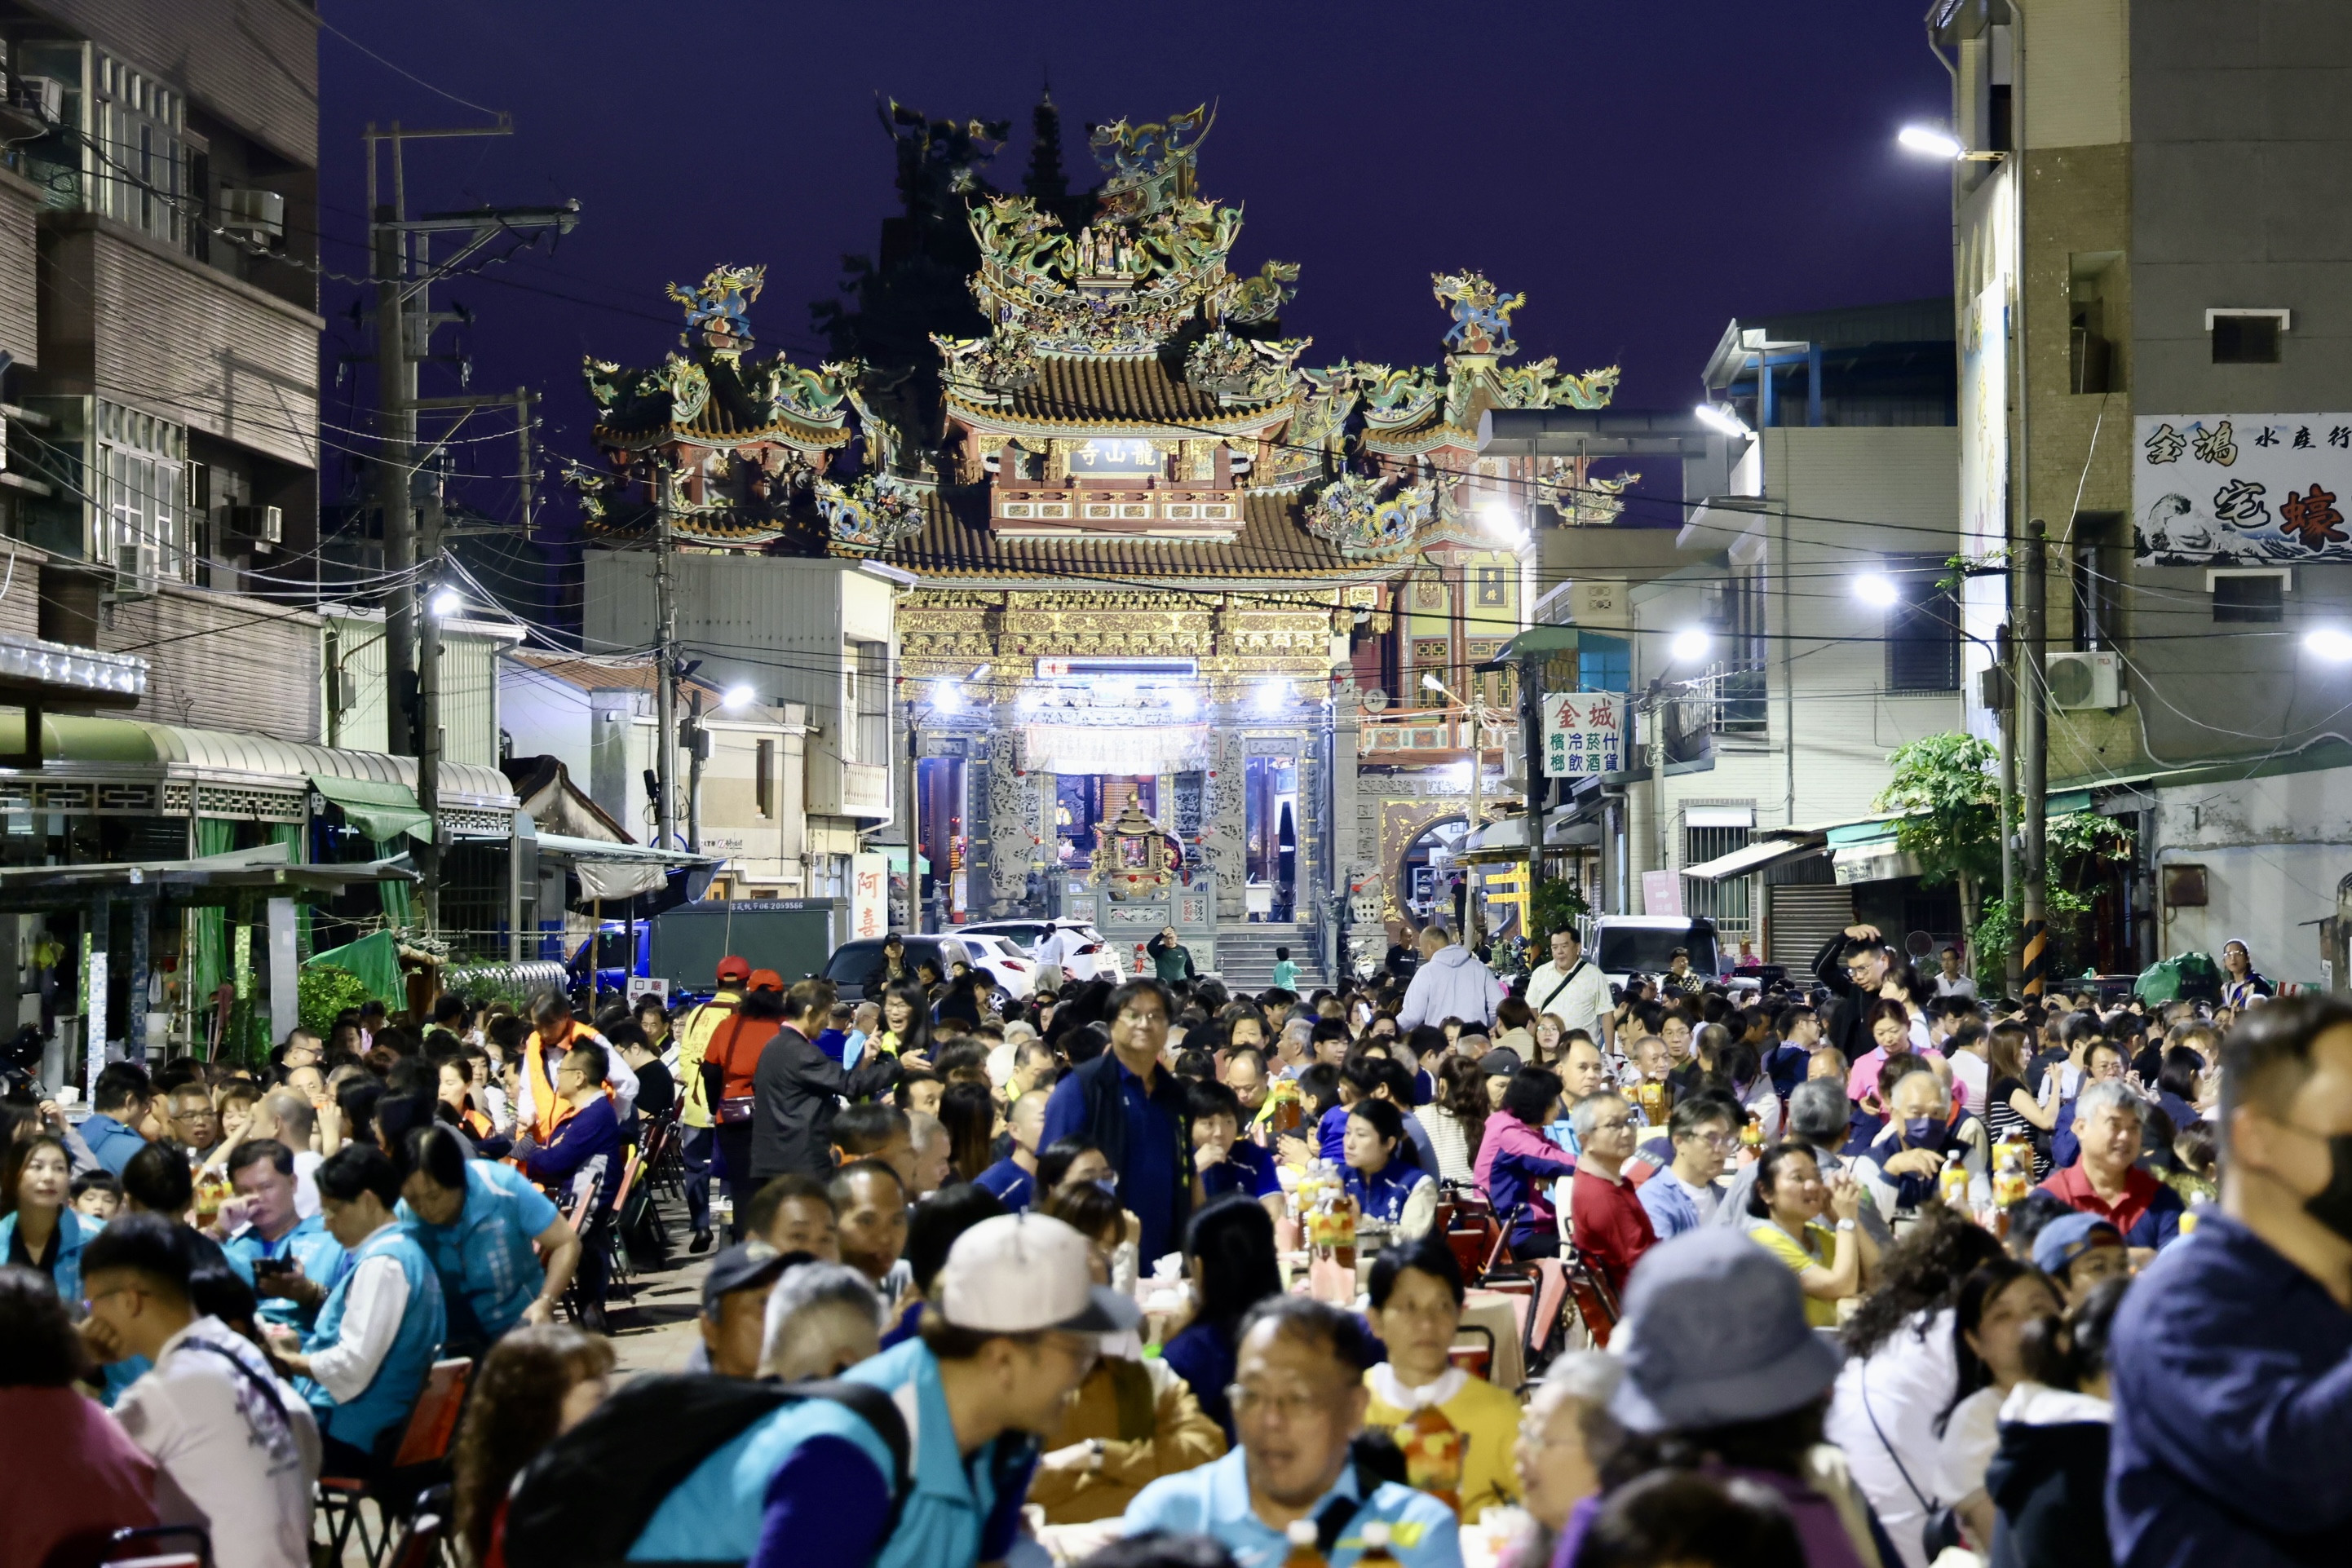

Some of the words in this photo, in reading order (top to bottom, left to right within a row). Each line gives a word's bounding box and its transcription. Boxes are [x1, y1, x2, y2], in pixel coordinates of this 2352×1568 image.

[2254, 425, 2352, 449] 水產行
[1554, 698, 1616, 730] 金城
[1568, 732, 1583, 771] 冷飲
[1586, 733, 1601, 771] 菸酒
[857, 872, 882, 937] 阿喜
